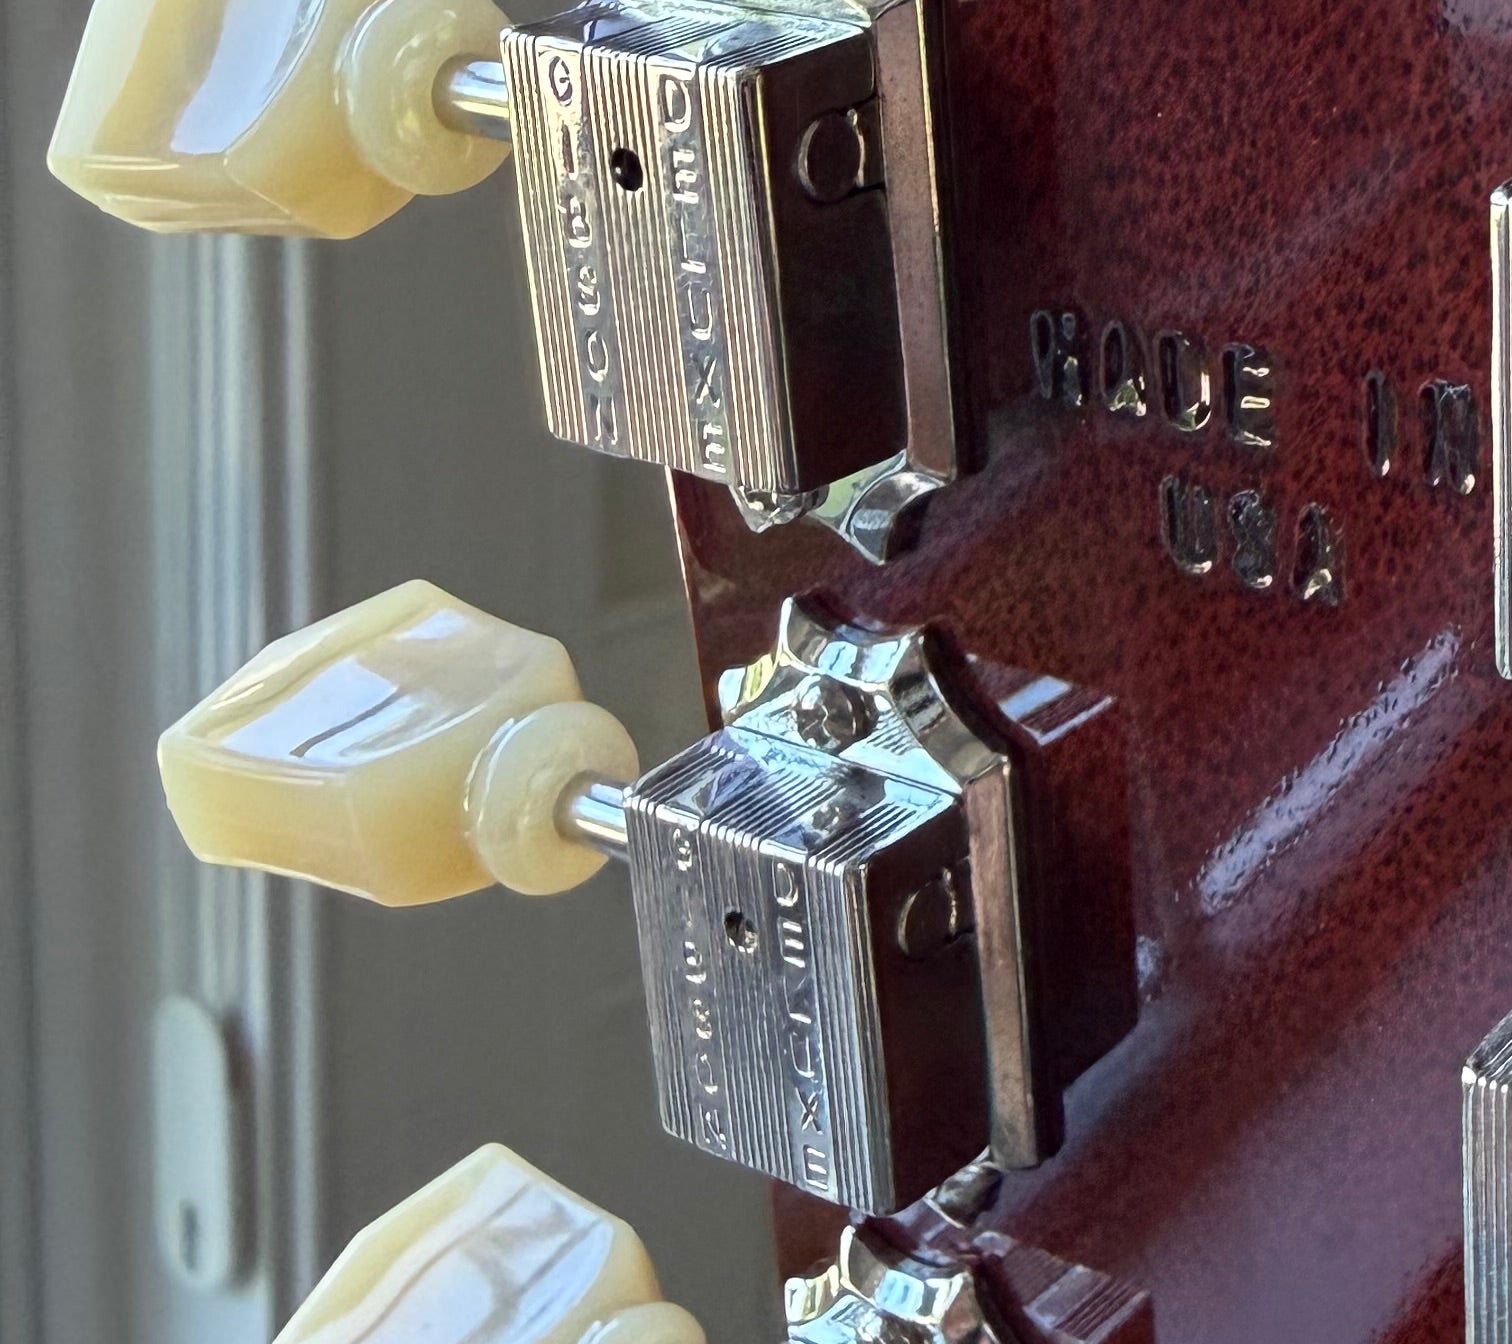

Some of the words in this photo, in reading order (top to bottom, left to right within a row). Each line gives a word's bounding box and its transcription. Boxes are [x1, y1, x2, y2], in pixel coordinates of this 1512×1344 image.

[548, 54, 620, 446] GIBSON
[659, 76, 728, 474] DELUXE
[1029, 310, 1275, 447] MADE
[1362, 367, 1480, 496] IN
[1160, 475, 1347, 607] USA
[772, 861, 829, 1191] DELUXE
